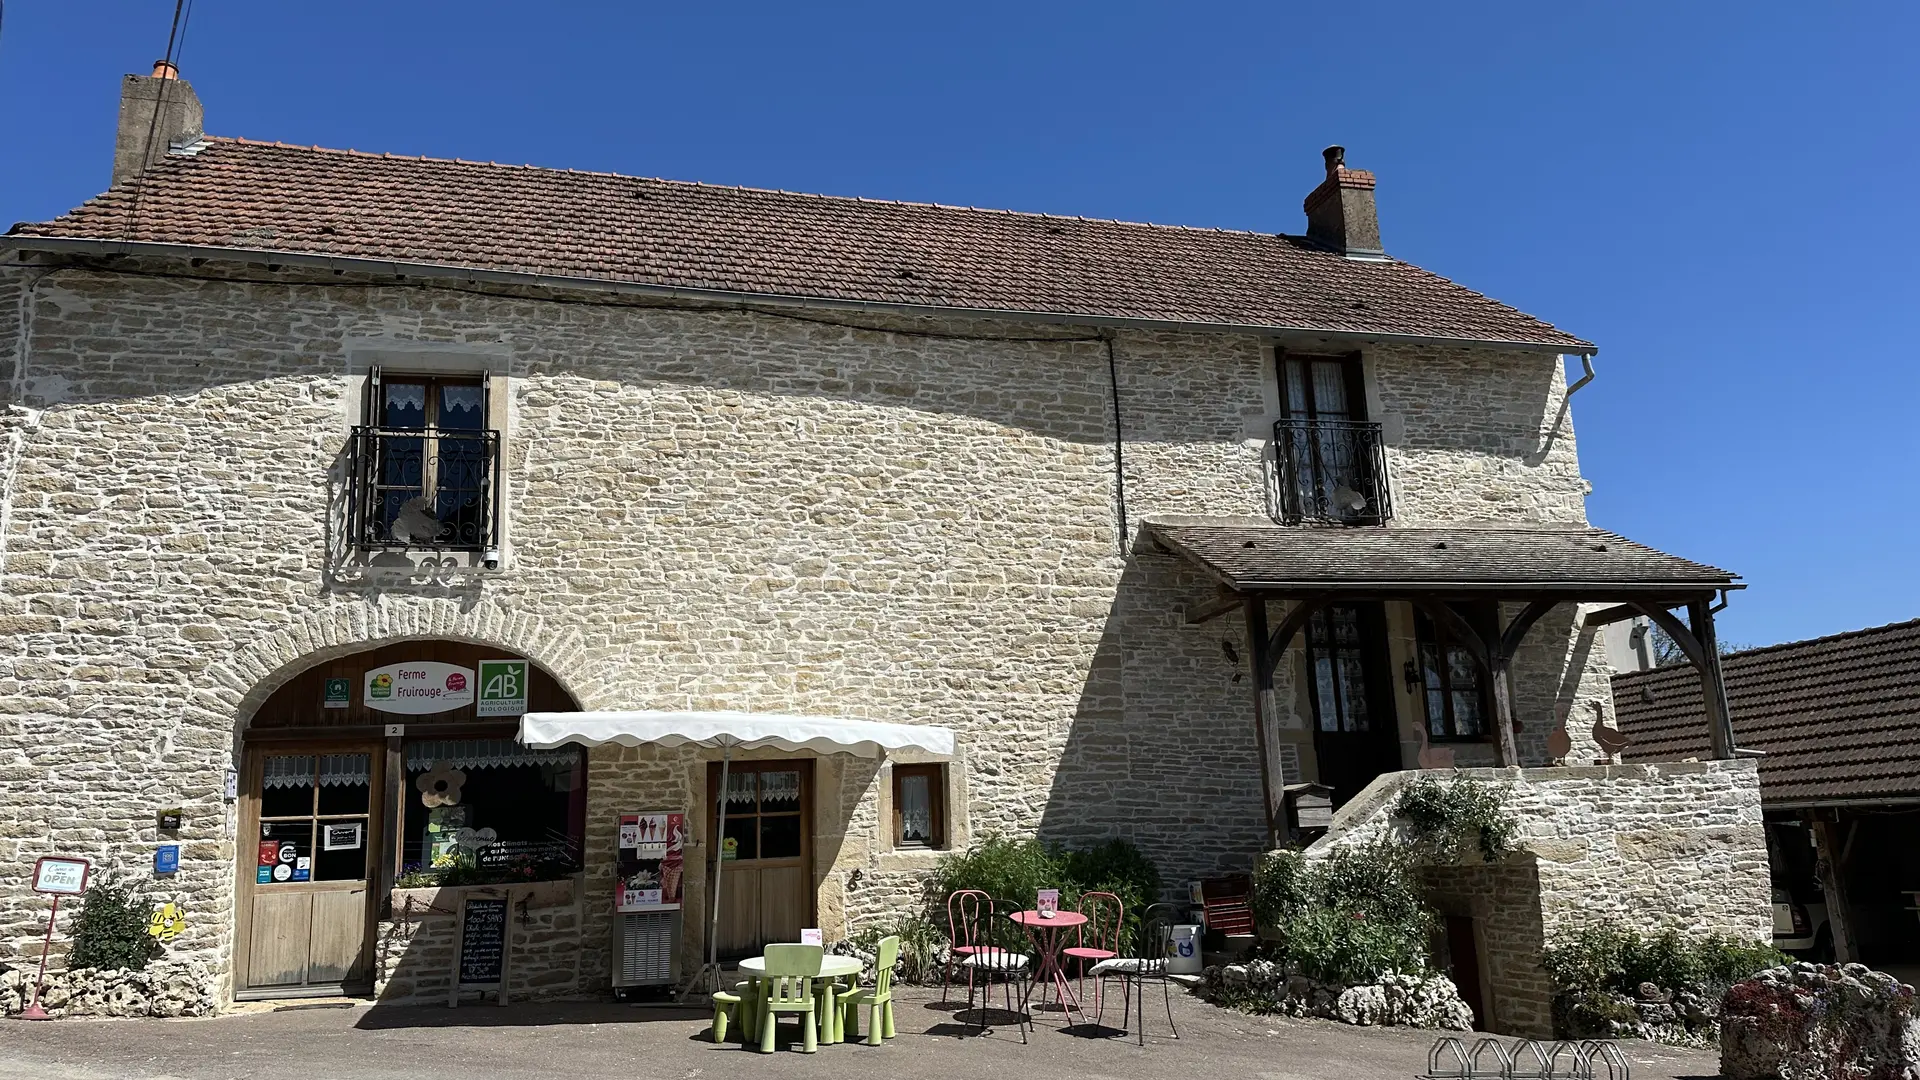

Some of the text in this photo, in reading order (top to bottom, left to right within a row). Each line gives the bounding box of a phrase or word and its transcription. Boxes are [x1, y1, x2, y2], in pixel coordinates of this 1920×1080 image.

[398, 669, 426, 680] Ferme
[483, 674, 518, 698] AB
[397, 686, 442, 698] Fruirouge
[392, 726, 398, 734] 2
[48, 864, 67, 872] Come
[43, 874, 75, 884] OPEN
[487, 913, 503, 923] SANS
